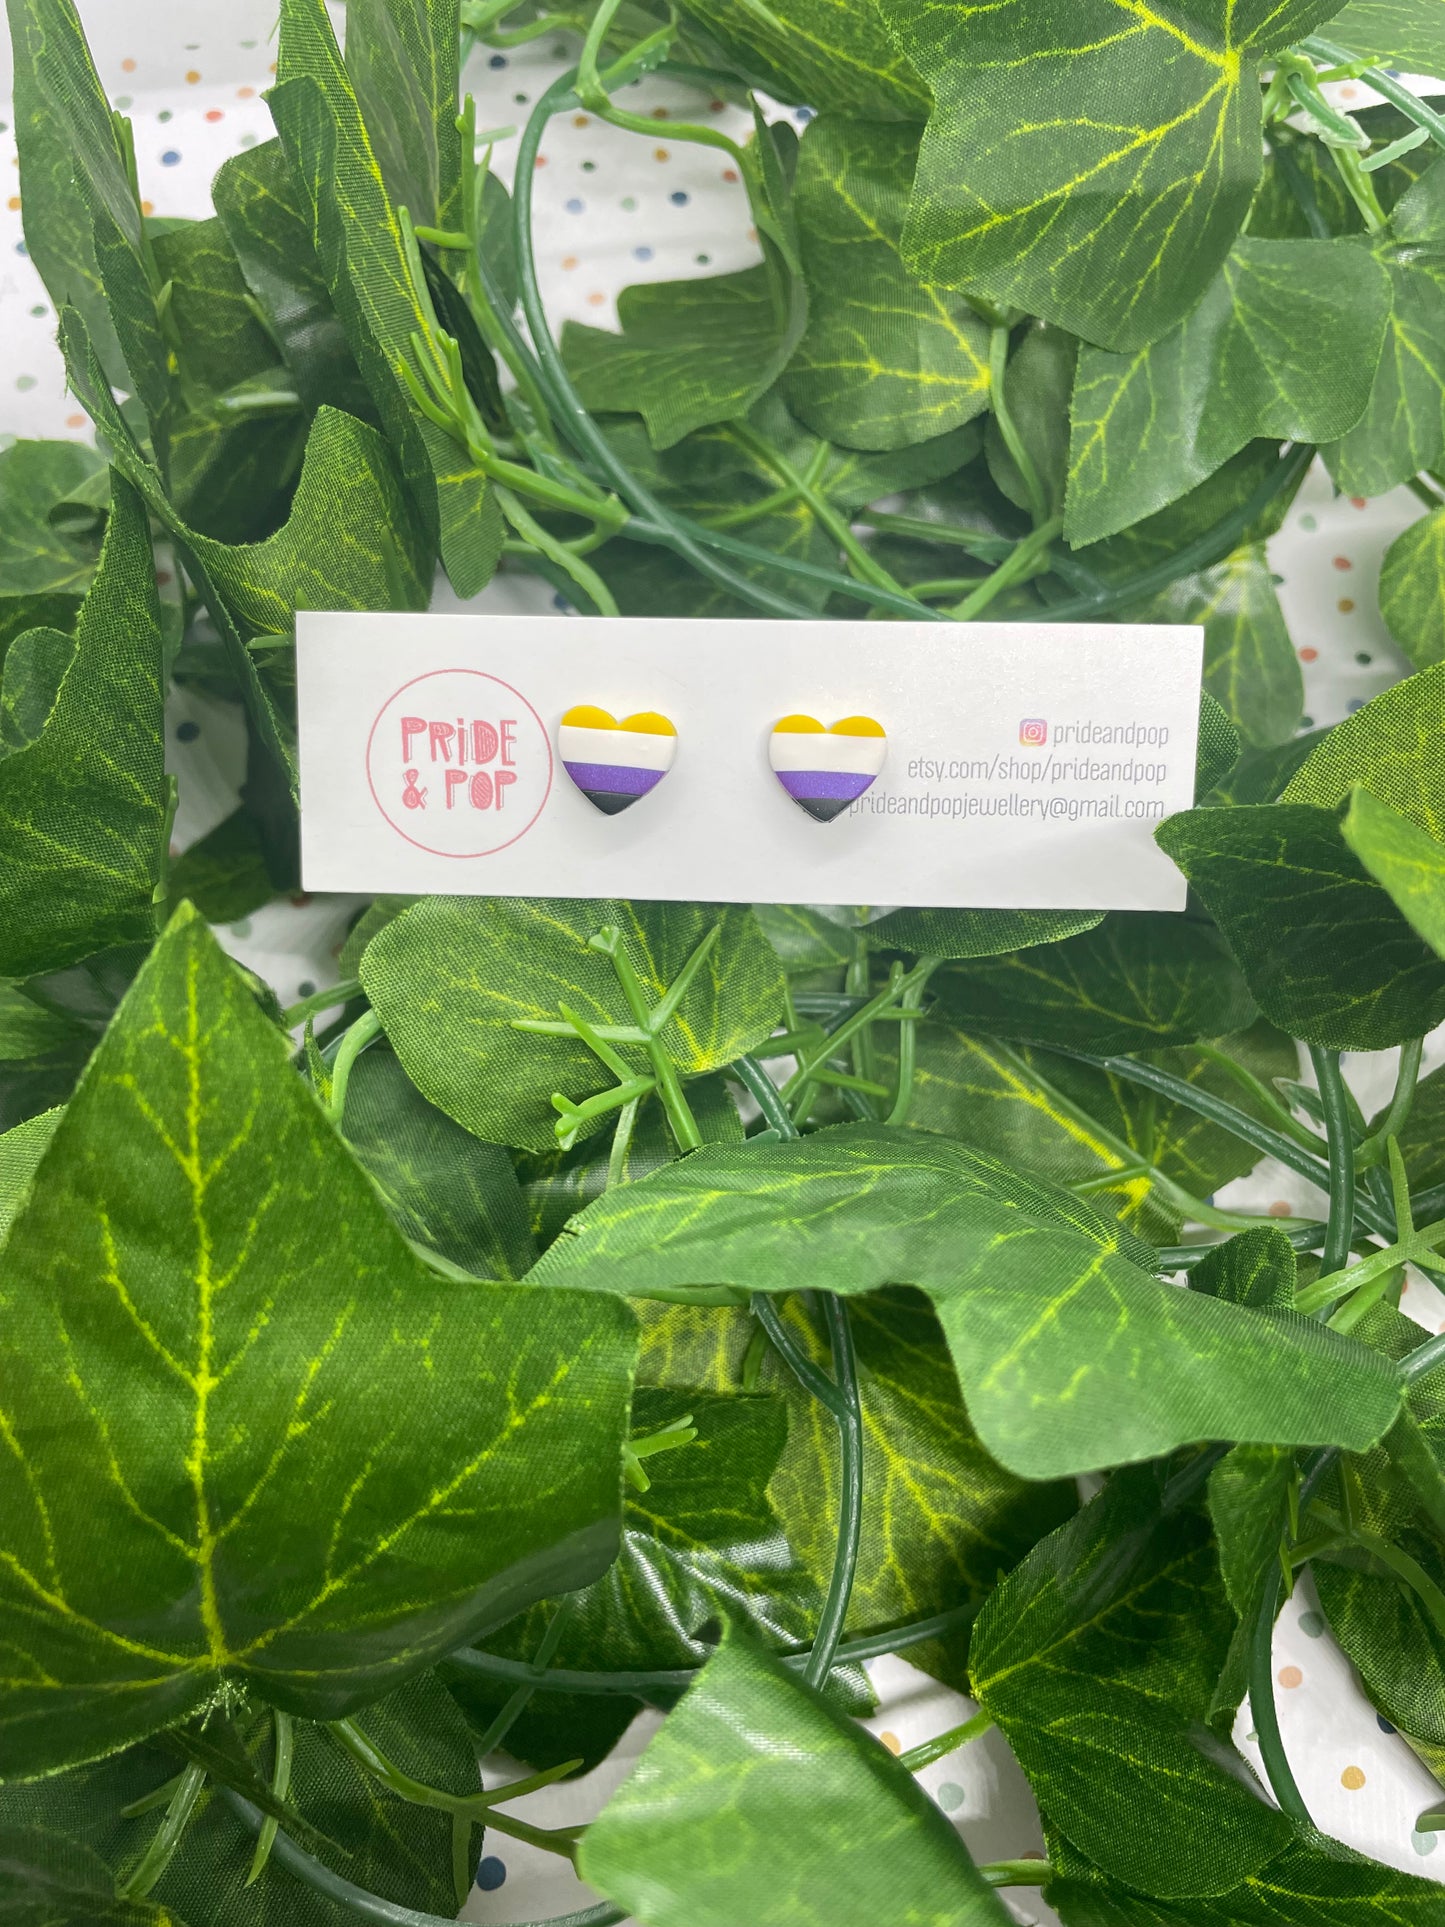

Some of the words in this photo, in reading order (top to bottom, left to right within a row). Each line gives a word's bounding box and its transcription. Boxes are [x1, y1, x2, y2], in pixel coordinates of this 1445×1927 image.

[1053, 720, 1169, 747] prideandpop
[908, 753, 1167, 785] etsy.com/shop/prideandpop
[402, 768, 428, 810] &
[444, 769, 518, 811] POP
